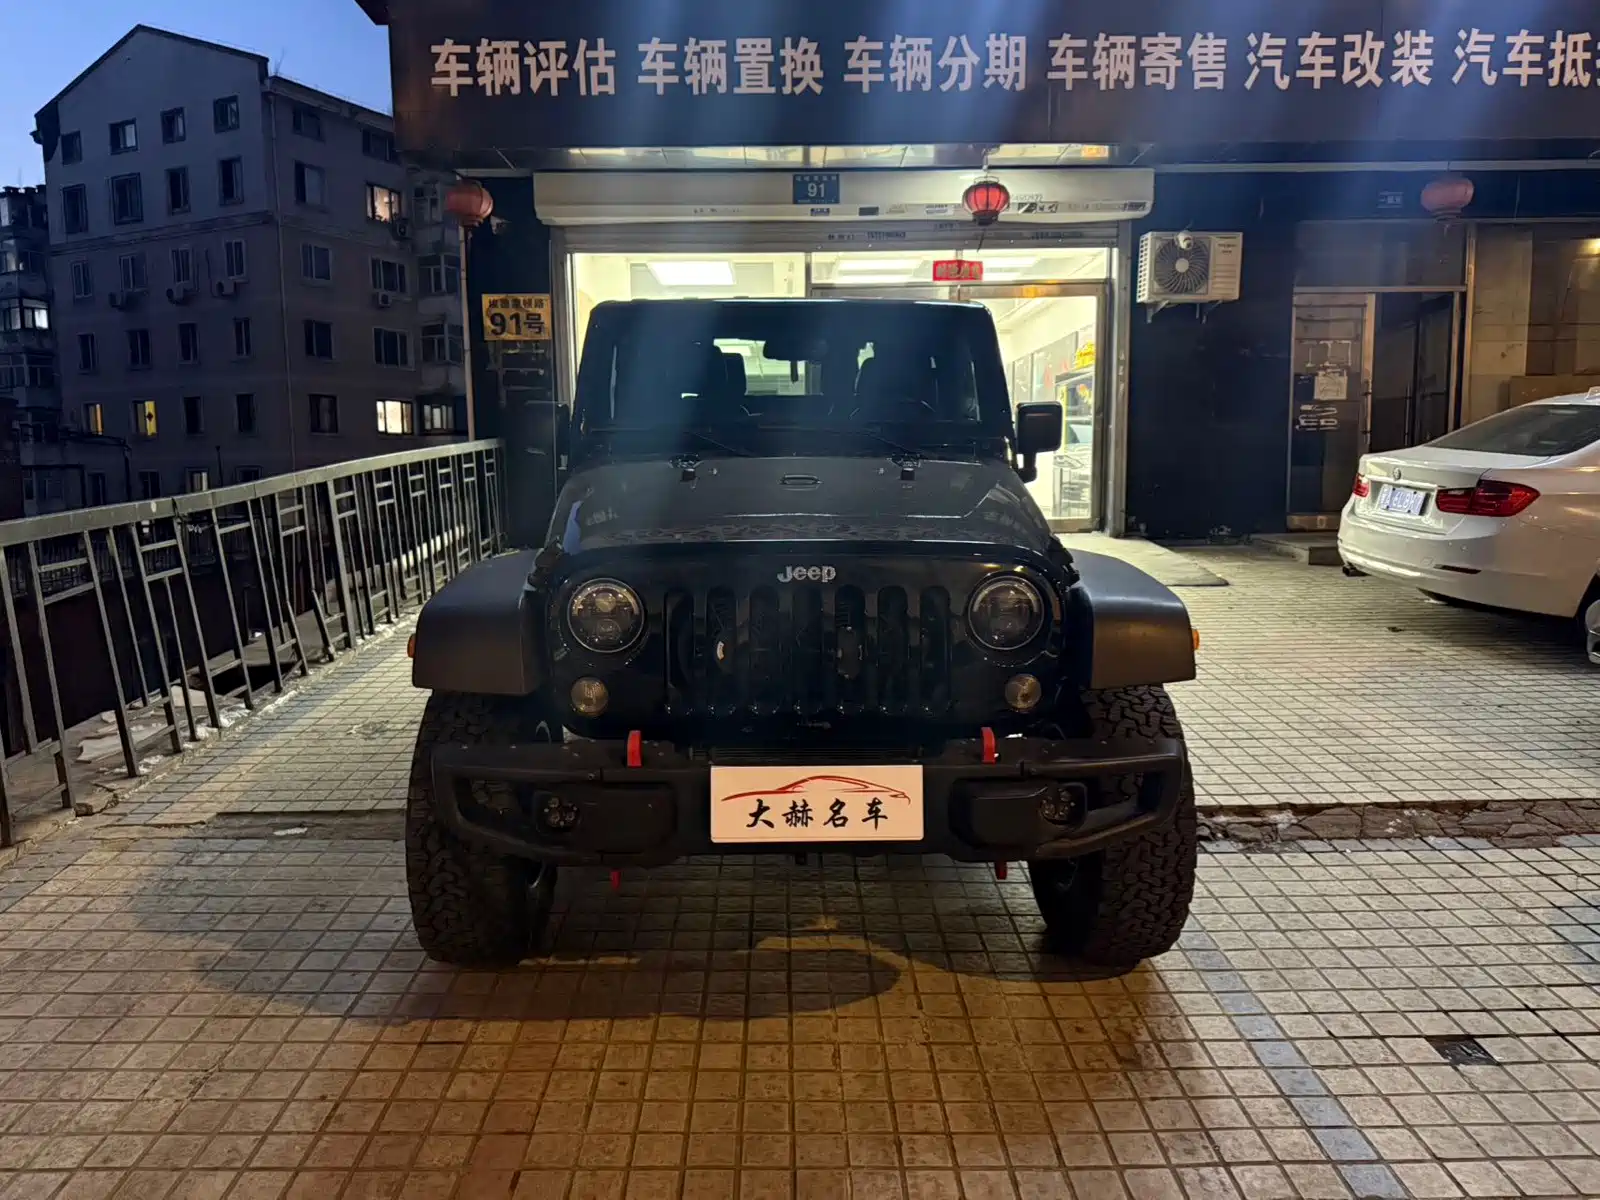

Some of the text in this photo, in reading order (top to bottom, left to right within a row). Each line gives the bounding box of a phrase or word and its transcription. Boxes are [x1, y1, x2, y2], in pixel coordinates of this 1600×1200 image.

[430, 27, 1600, 96] 车辆评估 车辆置换 车辆分期 车辆寄售 汽车改装 汽车抵
[807, 183, 825, 197] 91
[777, 565, 836, 582] Jeep
[746, 797, 888, 831] 大赫名车
